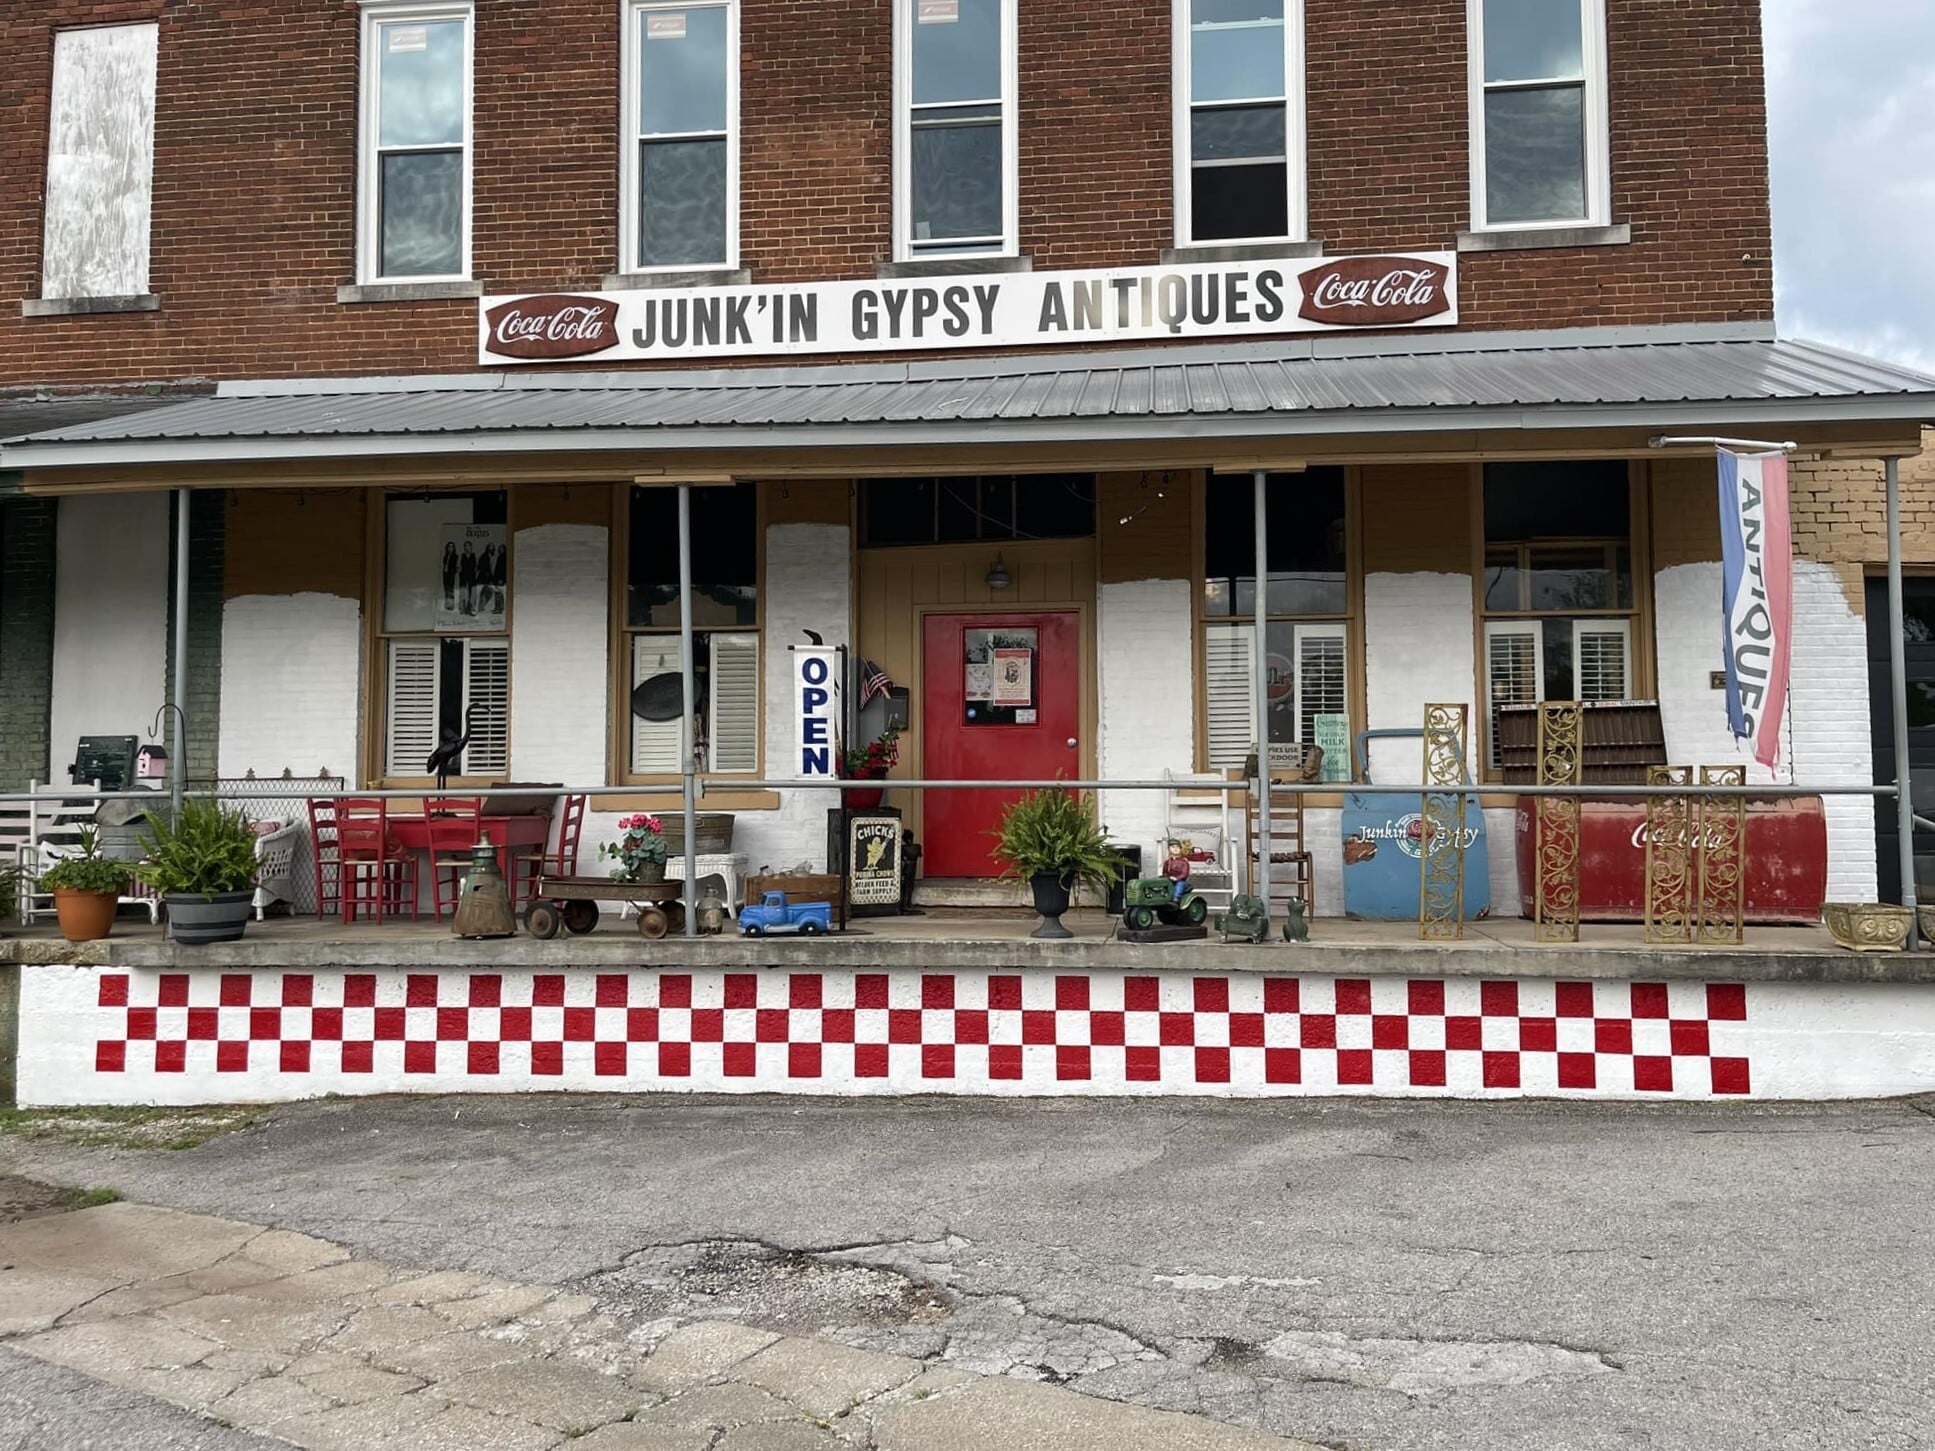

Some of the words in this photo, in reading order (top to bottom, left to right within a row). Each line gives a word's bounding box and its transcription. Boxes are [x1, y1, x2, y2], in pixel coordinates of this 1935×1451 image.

[632, 292, 818, 349] JUNK'IN
[852, 284, 1000, 340] GYPSY
[1038, 269, 1285, 334] ANTIQUES
[802, 657, 829, 775] OPEN
[1321, 738, 1345, 746] MILK
[857, 825, 895, 840] CHICKS
[1357, 820, 1408, 843] Junkin
